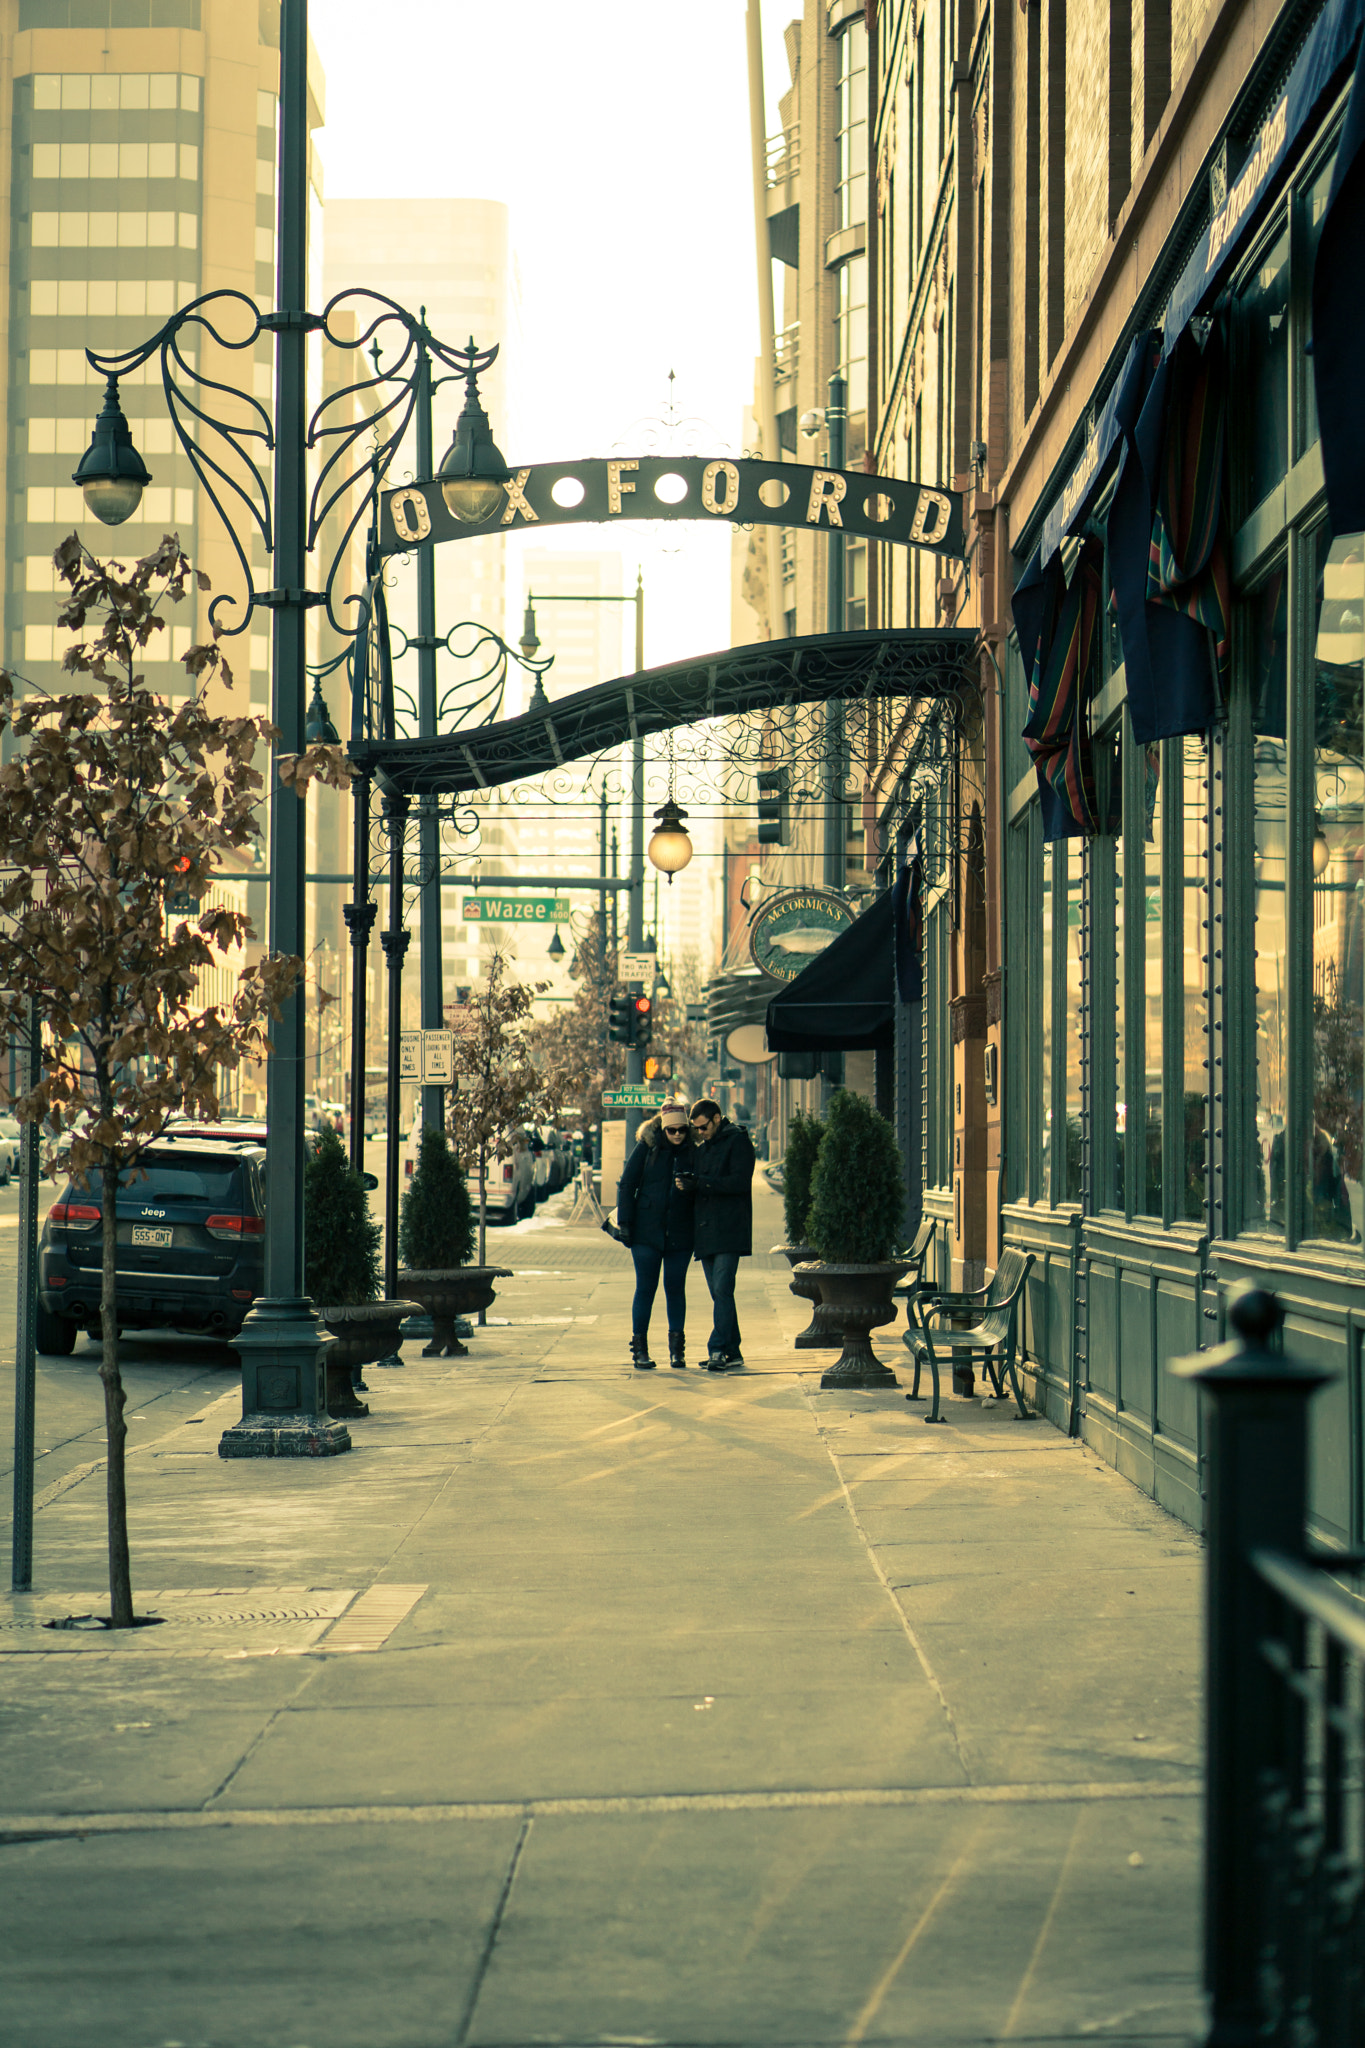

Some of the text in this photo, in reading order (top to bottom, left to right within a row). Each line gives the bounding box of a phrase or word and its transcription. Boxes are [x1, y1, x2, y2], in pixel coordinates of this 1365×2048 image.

[389, 460, 952, 544] OXFORD
[486, 900, 546, 919] Wazee
[555, 902, 563, 910] St
[550, 911, 568, 919] 1600
[768, 898, 843, 924] McCORMICK'S
[769, 961, 786, 977] Fish
[426, 1033, 450, 1041] PASSENGER
[401, 1045, 415, 1053] ONLY
[404, 1054, 412, 1062] ALL
[434, 1052, 442, 1060] ALL
[402, 1063, 415, 1071] TIMES
[432, 1061, 444, 1069] TIMES
[613, 1094, 633, 1105] JACK
[641, 1095, 657, 1105] WEIL
[141, 1207, 166, 1218] Jeep
